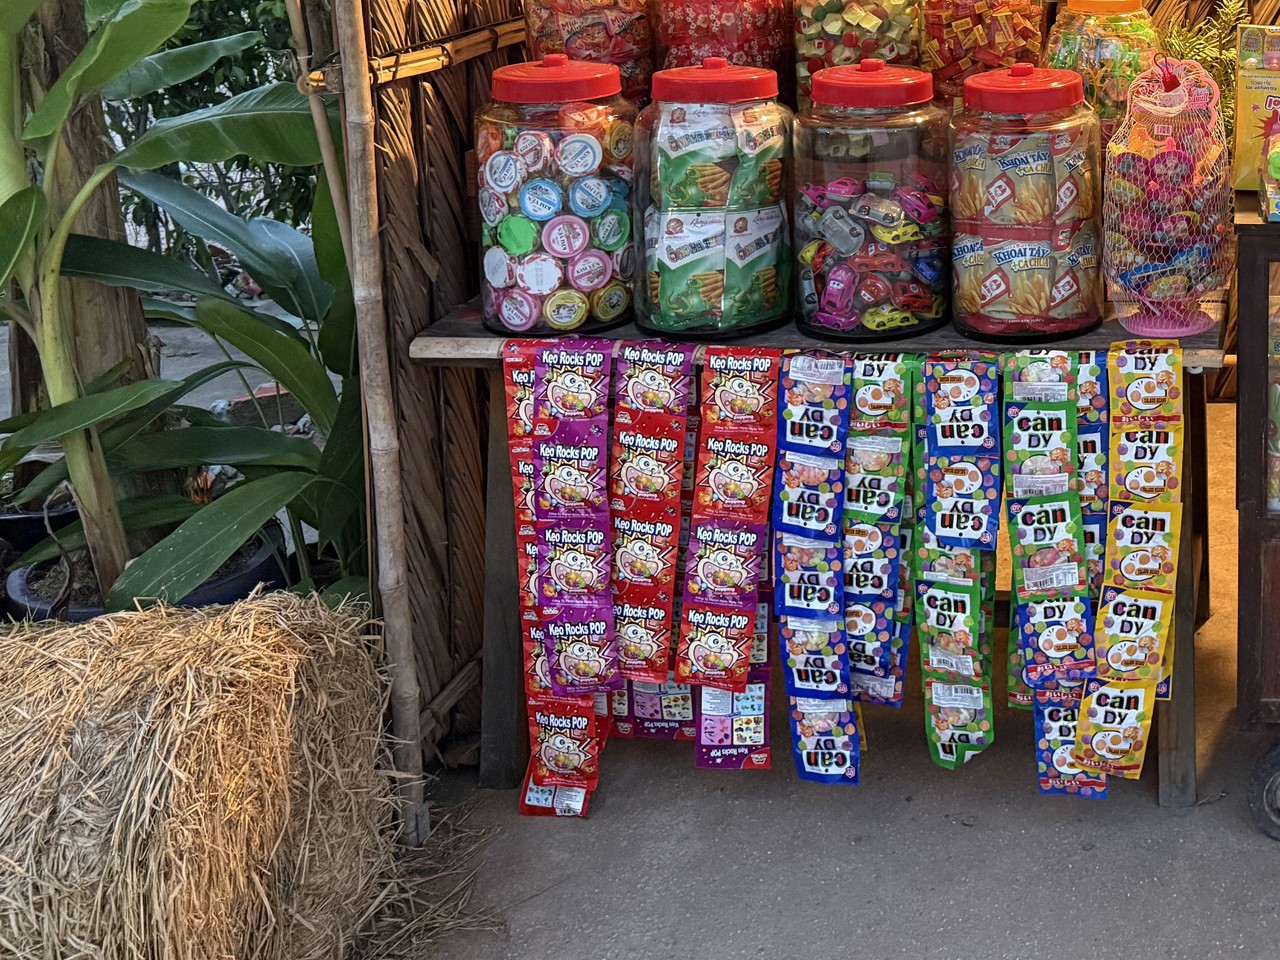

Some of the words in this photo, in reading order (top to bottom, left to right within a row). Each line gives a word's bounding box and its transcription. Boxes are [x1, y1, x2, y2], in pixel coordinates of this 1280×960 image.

[998, 157, 1032, 170] KHOAI
[993, 249, 1028, 265] KHOAI
[560, 352, 584, 366] Rocks
[586, 353, 603, 366] POP
[641, 349, 664, 363] Rocks
[666, 352, 684, 366] POP
[727, 357, 750, 370] Rocks
[752, 358, 771, 371] POP
[790, 422, 833, 439] can
[941, 424, 984, 438] can
[1018, 416, 1062, 431] can
[636, 435, 658, 449] Rocks
[660, 437, 677, 451] POP
[725, 441, 747, 455] Rocks
[749, 443, 767, 457] POP
[557, 446, 579, 459] Rocks
[581, 447, 598, 460] POP
[847, 488, 890, 507] can
[788, 502, 829, 522] can
[1022, 508, 1066, 525] can
[632, 519, 654, 534] Rocks
[655, 522, 672, 537] POP
[941, 514, 983, 531] can
[1122, 515, 1165, 532] can
[562, 530, 585, 542] Rocks
[587, 530, 604, 543] POP
[714, 530, 736, 544] Rocks
[738, 532, 756, 546] POP
[789, 585, 830, 603] can
[623, 604, 647, 618] Rocks
[648, 607, 665, 620] POP
[927, 595, 966, 614] can
[1113, 602, 1157, 620] can
[566, 623, 587, 635] Rocks
[589, 621, 606, 634] POP
[705, 613, 729, 626] Rocks
[731, 616, 748, 629] POP
[796, 669, 837, 684] can
[1096, 693, 1140, 710] can
[550, 714, 571, 728] Rocks
[572, 715, 587, 730] POP
[806, 752, 846, 767] can
